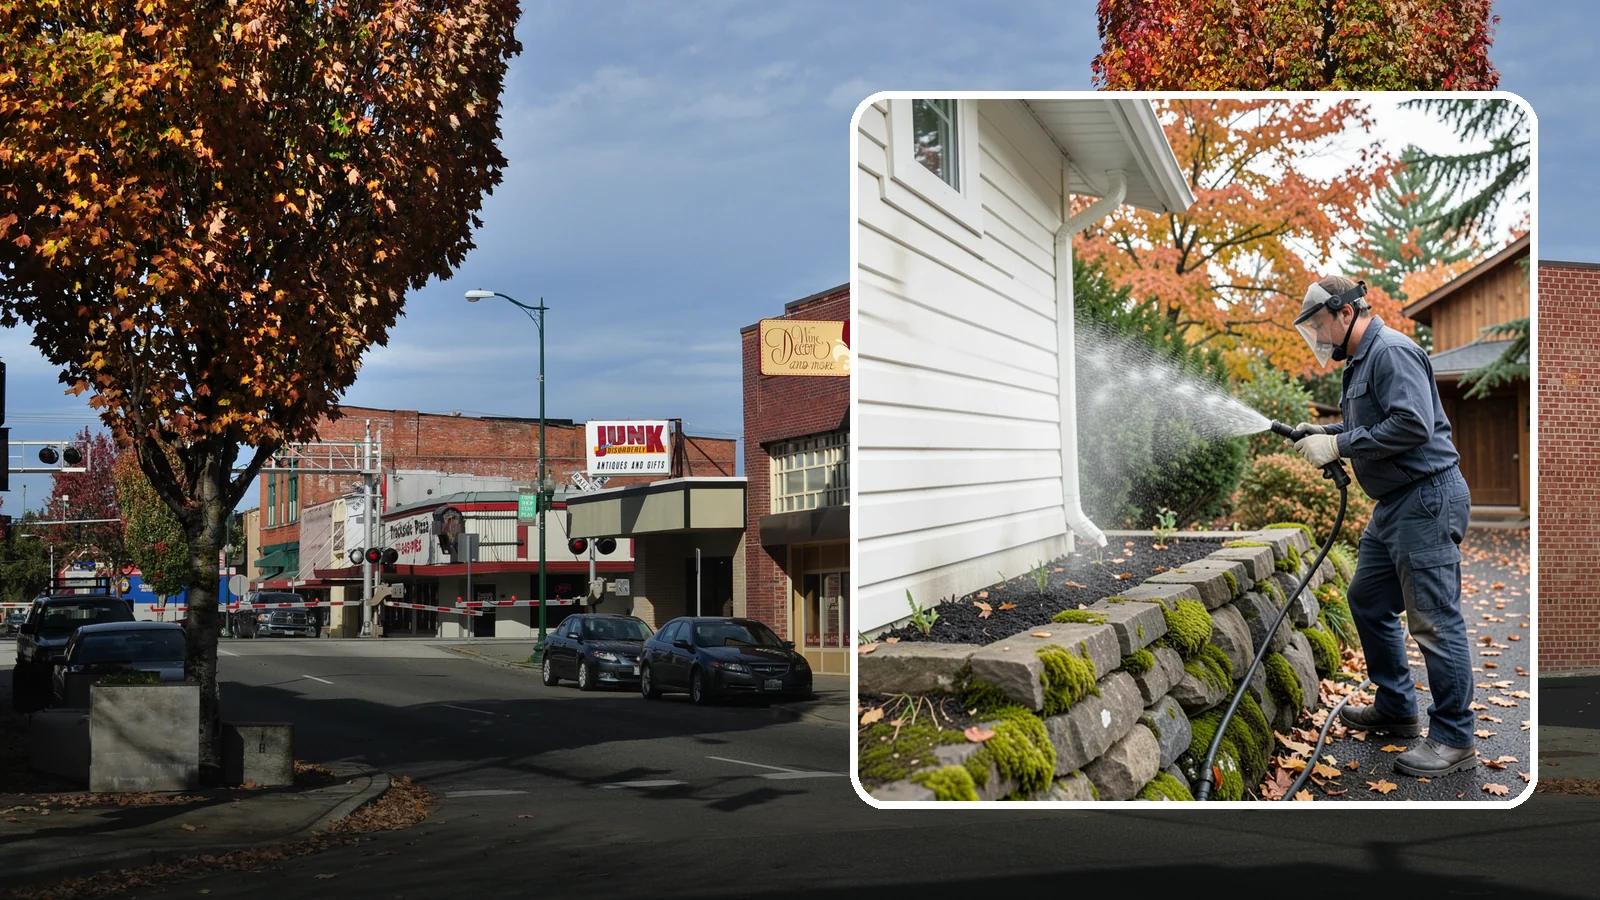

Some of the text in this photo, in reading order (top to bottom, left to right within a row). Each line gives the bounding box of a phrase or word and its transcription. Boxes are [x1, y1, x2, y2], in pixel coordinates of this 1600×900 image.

[596, 426, 665, 457] JUNK
[597, 461, 665, 470] ANTIQUES AND GIFTS
[390, 519, 429, 540] Trackside Pizza
